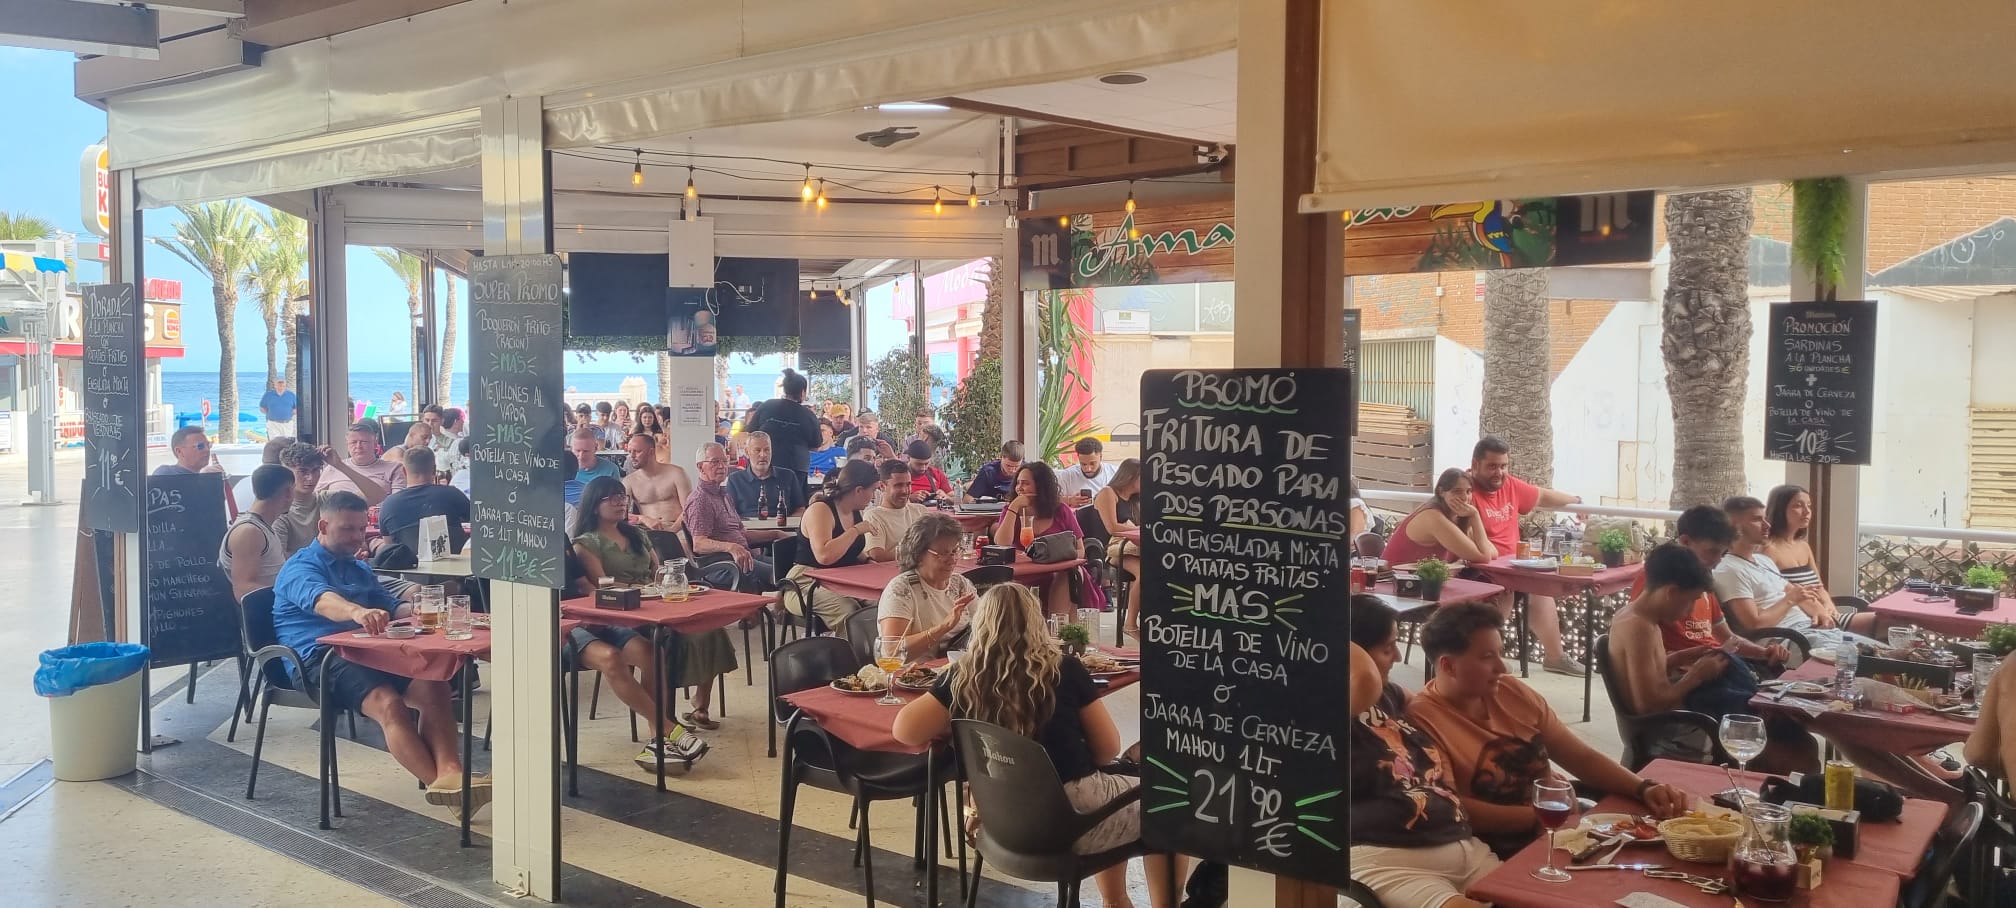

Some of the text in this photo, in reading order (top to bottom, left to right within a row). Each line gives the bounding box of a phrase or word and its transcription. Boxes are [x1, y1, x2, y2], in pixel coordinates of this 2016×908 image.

[474, 271, 558, 301] SUPER PROMO
[524, 315, 552, 336] FRITO
[1784, 338, 1842, 352] SARDINAS
[1785, 352, 1851, 364] A LA PLANCHA
[480, 376, 544, 408] MEJILLONES AL
[1774, 384, 1856, 399] JARRA DE CERVEZA
[1804, 400, 1814, 409] O
[500, 403, 527, 425] VAPOR
[1768, 406, 1854, 417] BOTELLA DE VINO DE
[1788, 416, 1796, 424] LA
[473, 443, 560, 469] BOTELLA DE VINO DE
[1277, 430, 1334, 460] DE
[1796, 452, 1812, 462] LAS
[494, 465, 530, 485] LA CASA
[1146, 452, 1339, 500] PESCADO PARA
[474, 500, 555, 532] JARRA DE CERVEZA
[1154, 491, 1347, 536] DOS PERSONAS
[480, 524, 495, 538] DE
[516, 528, 548, 549] MAHOU
[1188, 529, 1283, 562] ENSALADA
[1290, 540, 1339, 569] MIXTA
[1162, 553, 1176, 570] O
[1178, 554, 1250, 582] PATATAS
[1194, 583, 1272, 620] MÁS
[1145, 614, 1329, 664] BOTELLA DE VINO
[1167, 650, 1288, 686] DE LA CASA
[1144, 693, 1204, 731] JARRA
[1209, 714, 1233, 734] DE
[1241, 715, 1337, 760] CERVEZA
[1166, 727, 1225, 762] MAHOU
[1254, 822, 1297, 857] €
